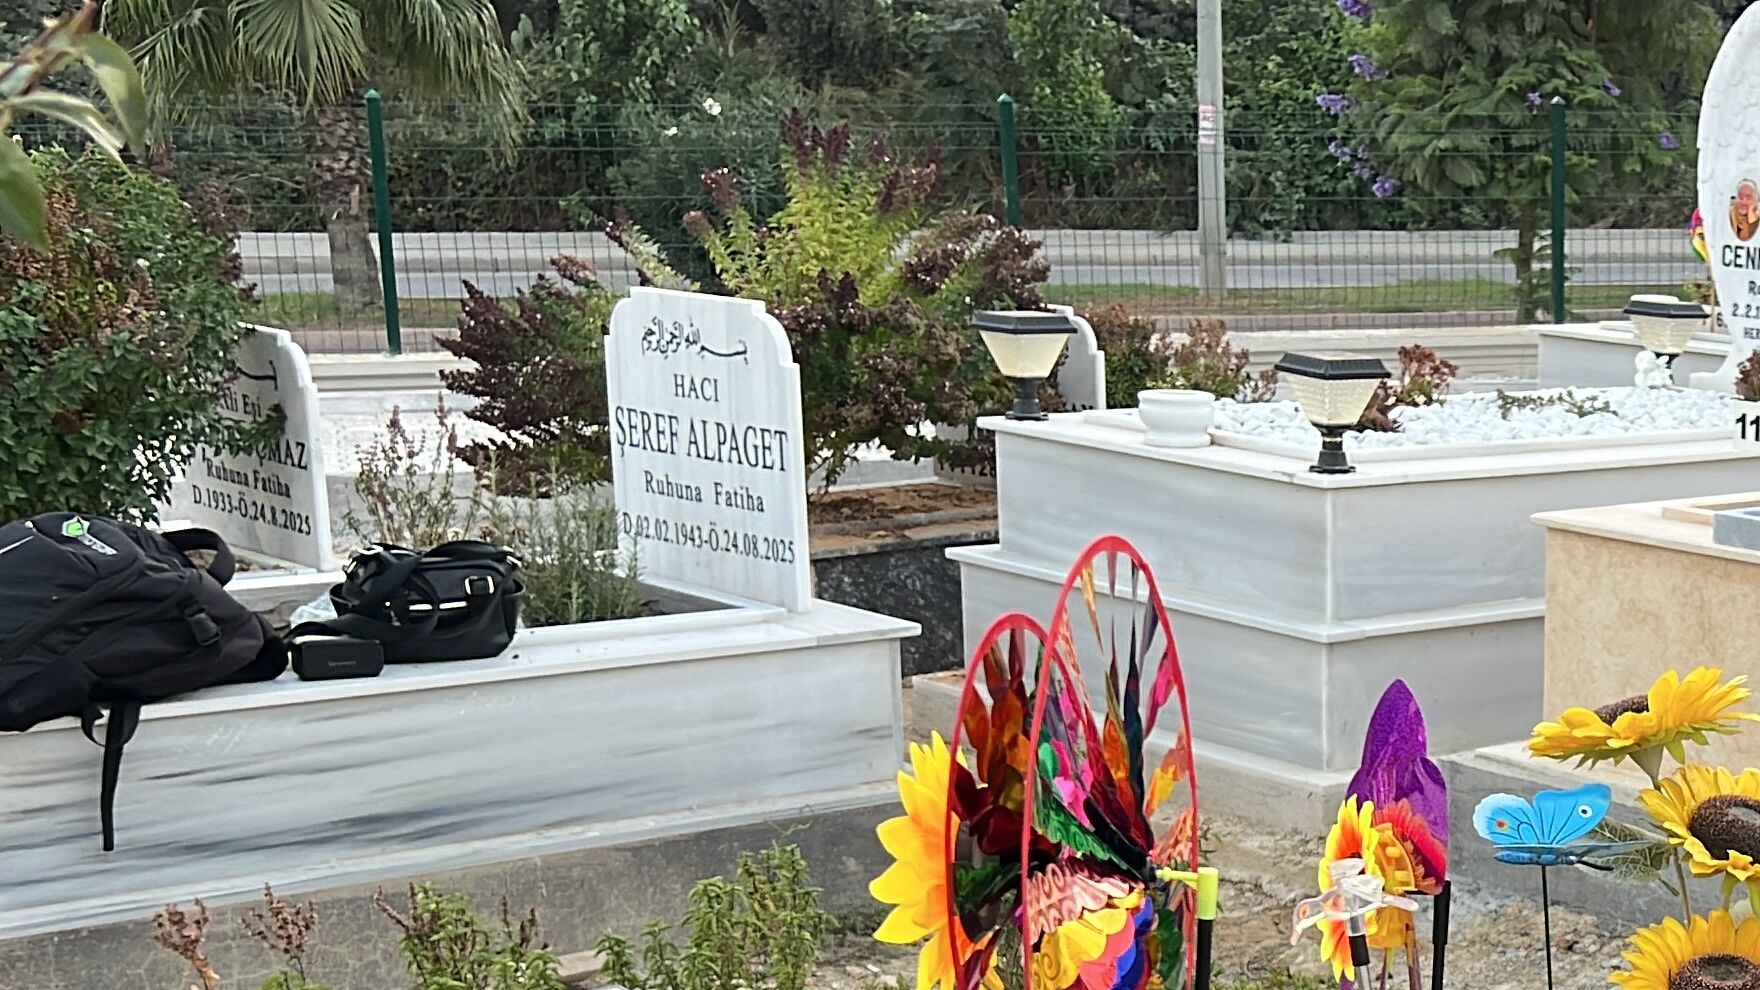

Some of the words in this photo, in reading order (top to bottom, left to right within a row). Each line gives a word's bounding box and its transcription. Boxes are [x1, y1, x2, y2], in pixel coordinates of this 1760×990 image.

[673, 373, 720, 403] HACI
[615, 405, 680, 457] ŞEREF
[687, 415, 789, 472] ALPAGET
[206, 458, 250, 488] Ruhuna
[253, 469, 292, 499] Fatiha
[643, 470, 704, 503] Ruhuna
[714, 481, 765, 512] Fatiha
